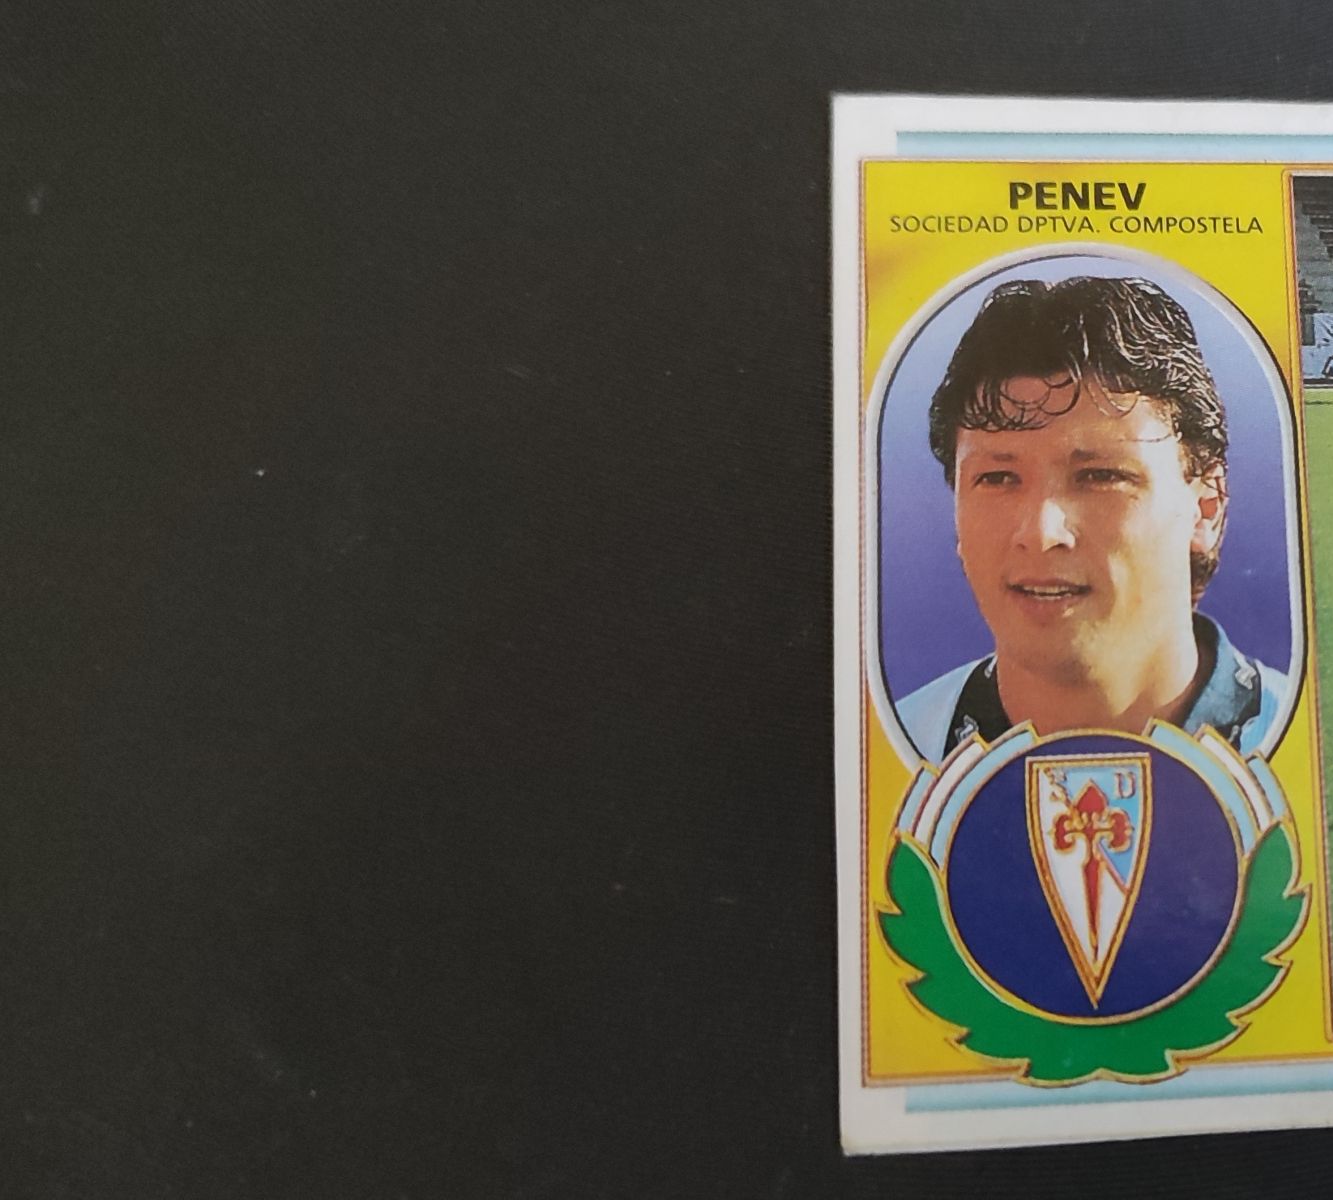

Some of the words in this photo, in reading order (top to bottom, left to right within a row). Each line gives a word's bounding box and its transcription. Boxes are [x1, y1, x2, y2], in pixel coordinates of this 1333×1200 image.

[1008, 181, 1147, 211] PENEV
[889, 215, 1009, 234] SOCIEDAD
[1018, 216, 1101, 234] DPTVA.
[1109, 215, 1264, 235] COMPOSTELA
